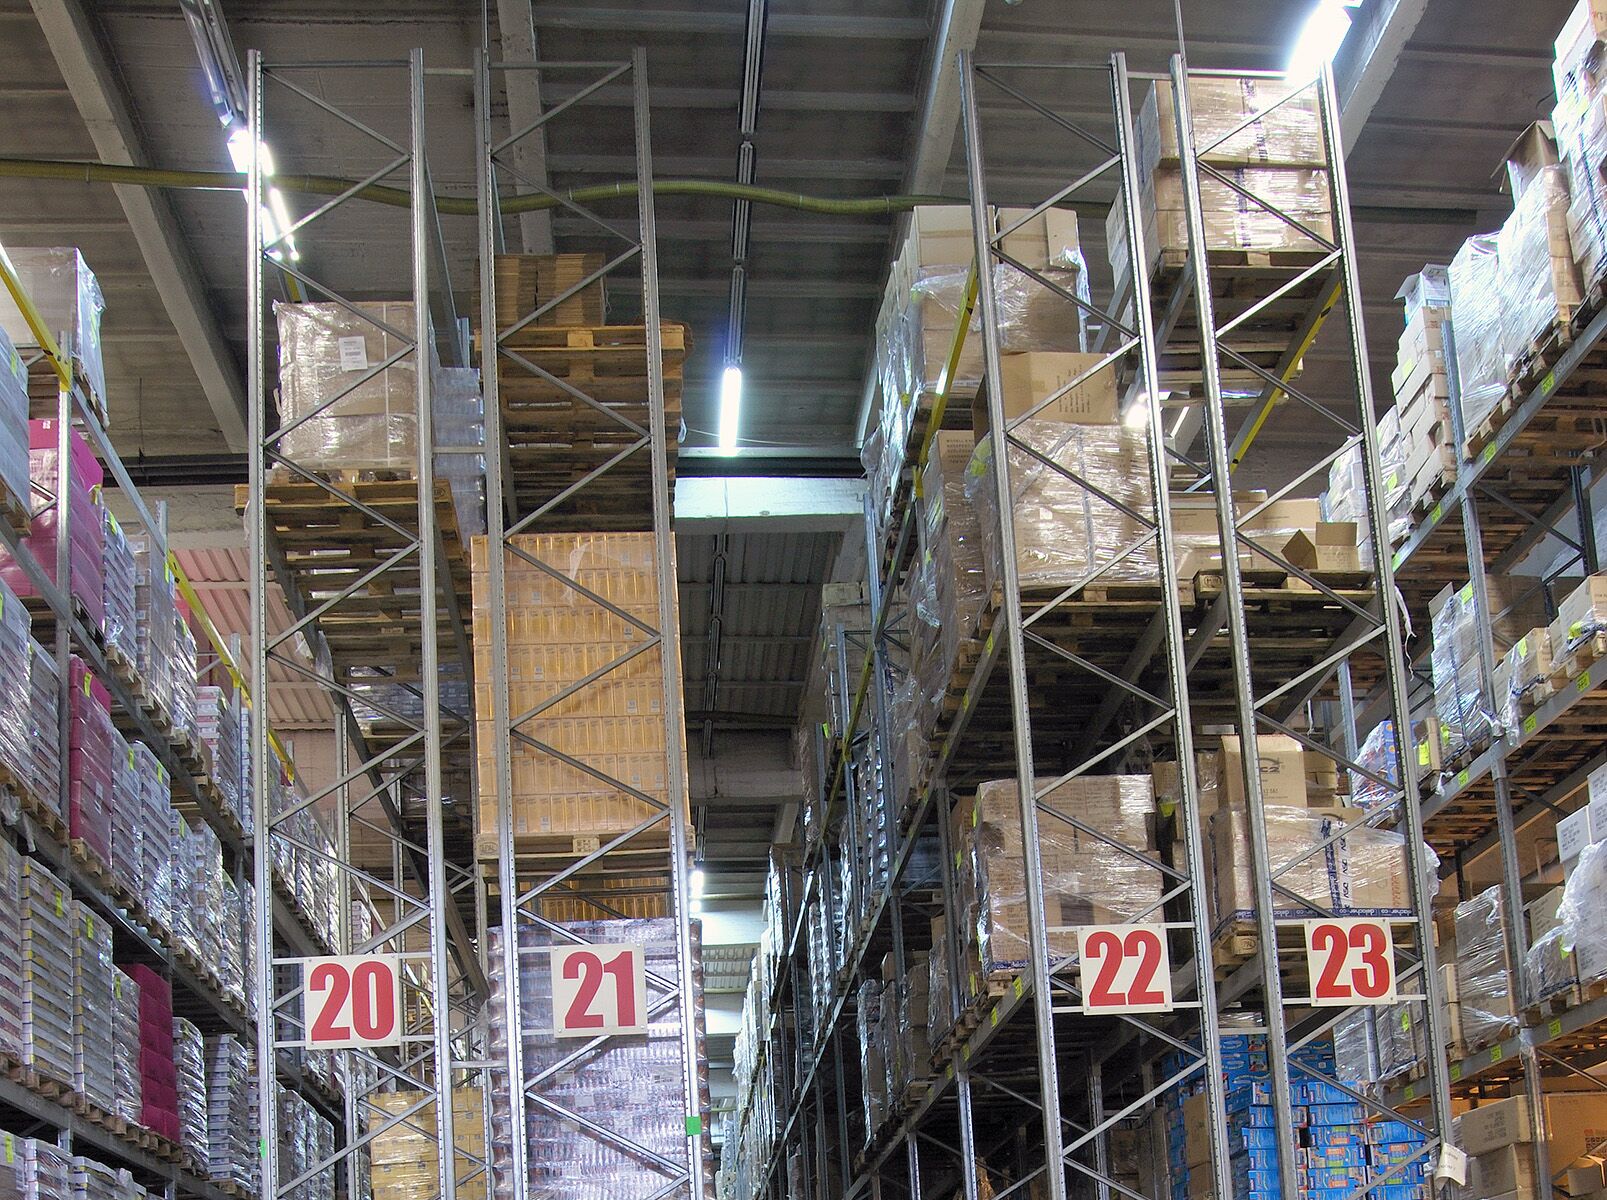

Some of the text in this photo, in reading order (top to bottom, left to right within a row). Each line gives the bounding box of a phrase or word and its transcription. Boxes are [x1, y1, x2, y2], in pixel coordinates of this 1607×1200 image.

[562, 951, 636, 1029] 21
[1085, 930, 1165, 1006] 22
[1312, 923, 1390, 998] 23
[310, 961, 394, 1041] 20
